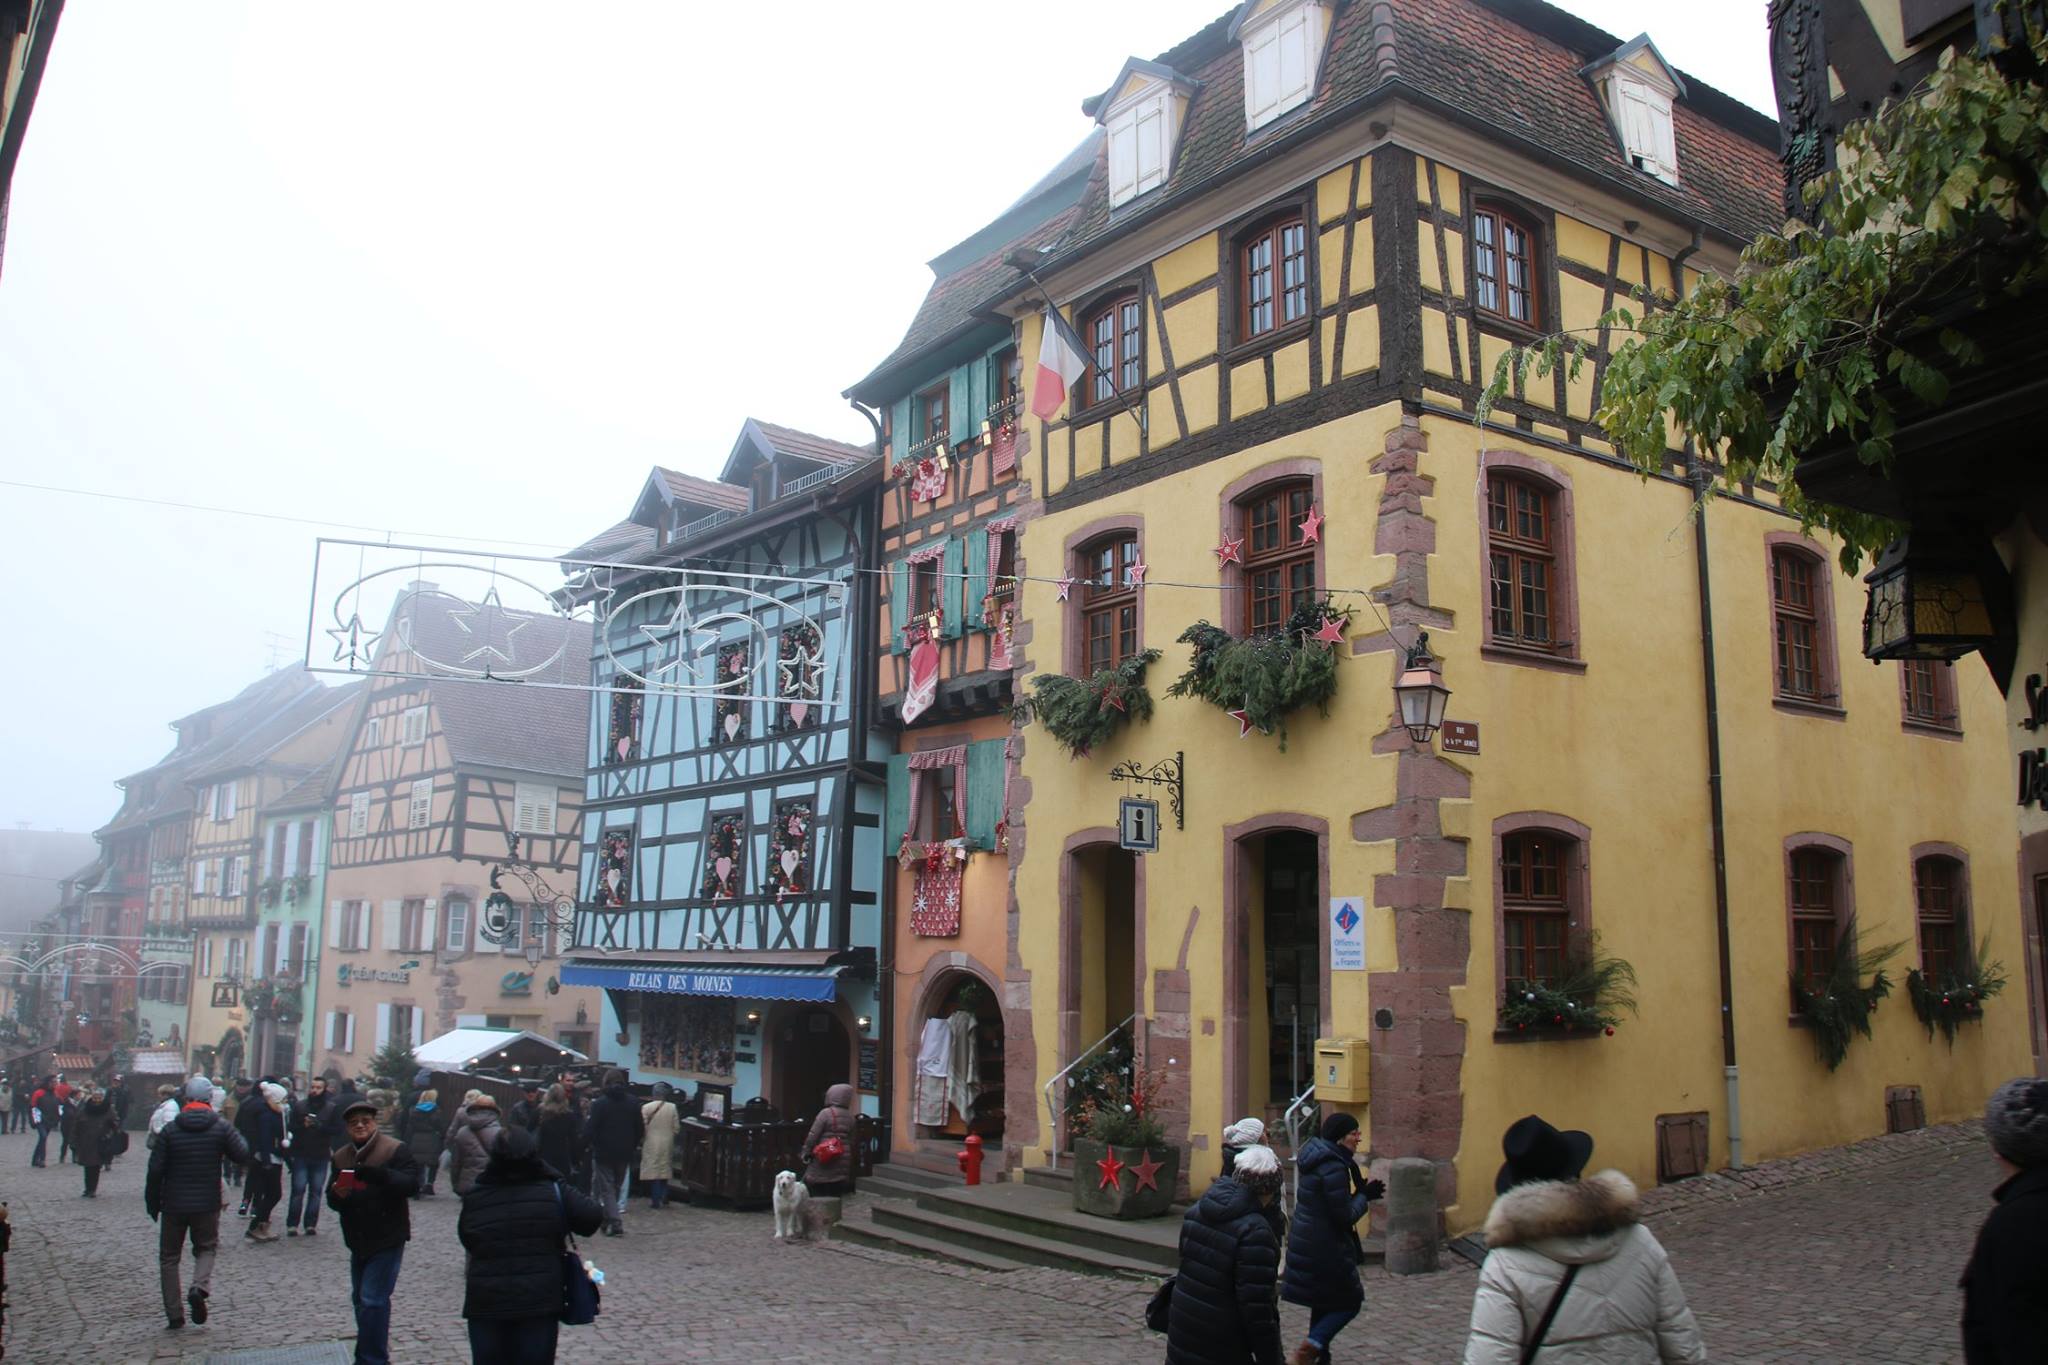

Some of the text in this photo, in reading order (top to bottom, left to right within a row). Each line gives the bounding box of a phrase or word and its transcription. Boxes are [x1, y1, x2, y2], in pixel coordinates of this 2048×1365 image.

[1133, 809, 1146, 841] i
[628, 972, 733, 993] RELAIS DES MOINES
